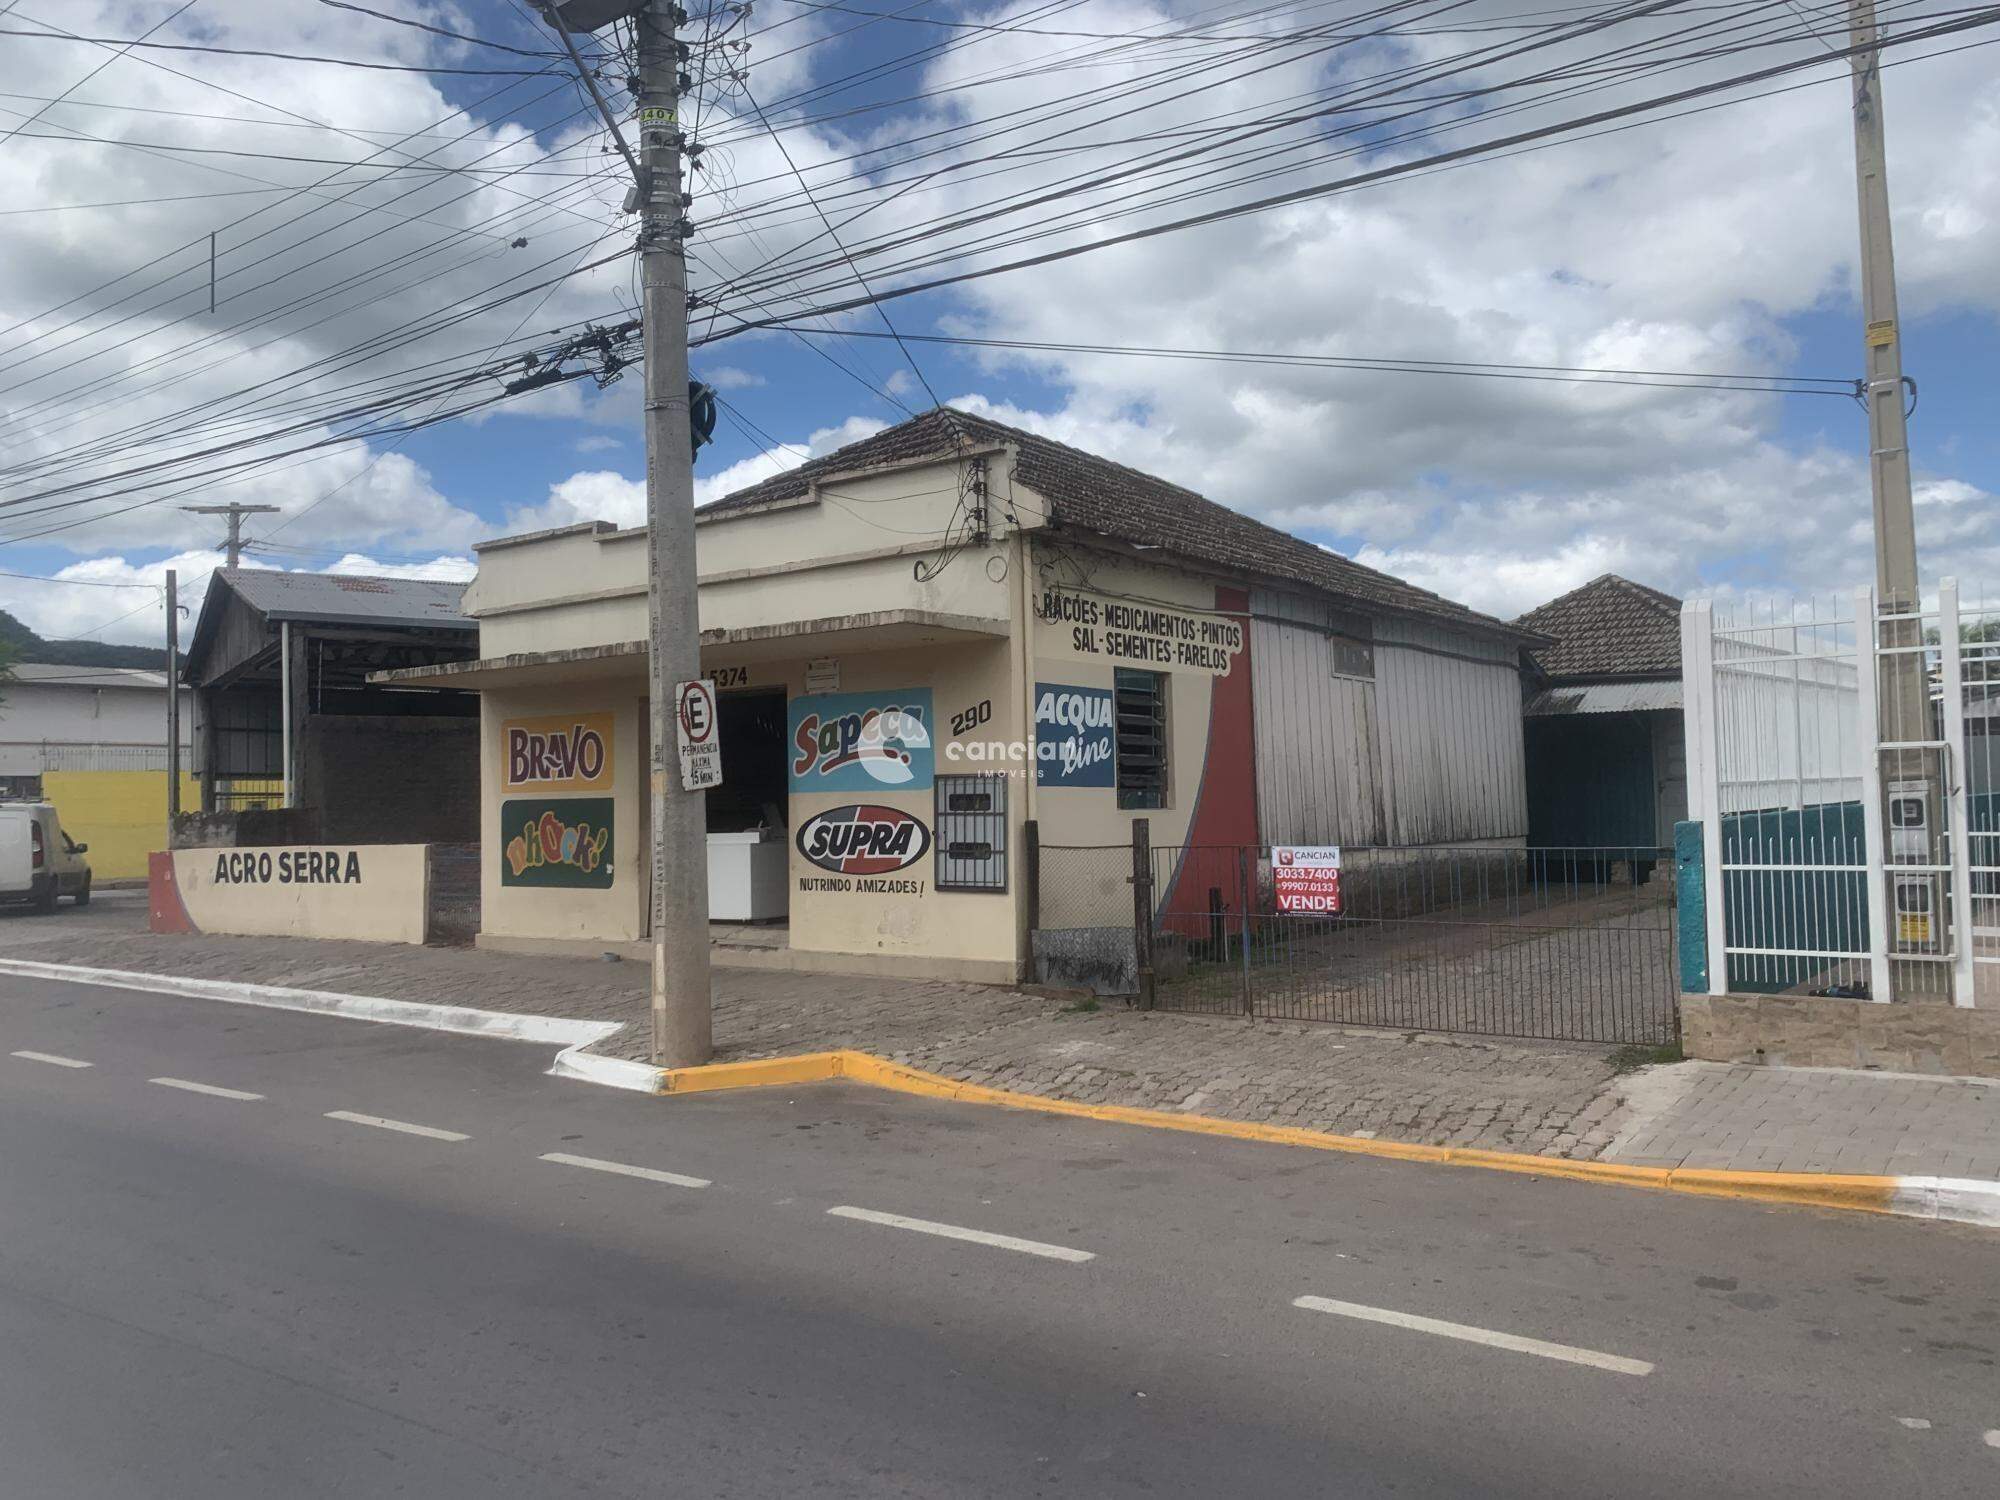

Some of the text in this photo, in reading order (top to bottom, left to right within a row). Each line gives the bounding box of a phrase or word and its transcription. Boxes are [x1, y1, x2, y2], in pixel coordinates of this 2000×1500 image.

[1105, 604, 1195, 640] MEDICAMENTOS
[1202, 621, 1240, 648] PINTOS
[1073, 627, 1099, 653] SAL
[1106, 632, 1171, 662] SEMENTES
[1178, 642, 1227, 670] FARELOS
[689, 697, 704, 729] E
[951, 700, 991, 736] 290
[1035, 692, 1113, 735] ACQUA
[508, 724, 605, 785] BRAVO
[794, 705, 926, 777] Sapeca
[807, 822, 916, 858] SUPRA
[1294, 851, 1336, 860] CANCIAN
[215, 851, 361, 884] AGRO SERRA
[800, 878, 851, 891] NUTRINDO
[1276, 868, 1337, 880] 3033.7400
[1280, 895, 1336, 911] VENDE
[1281, 881, 1334, 892] 99907.0133
